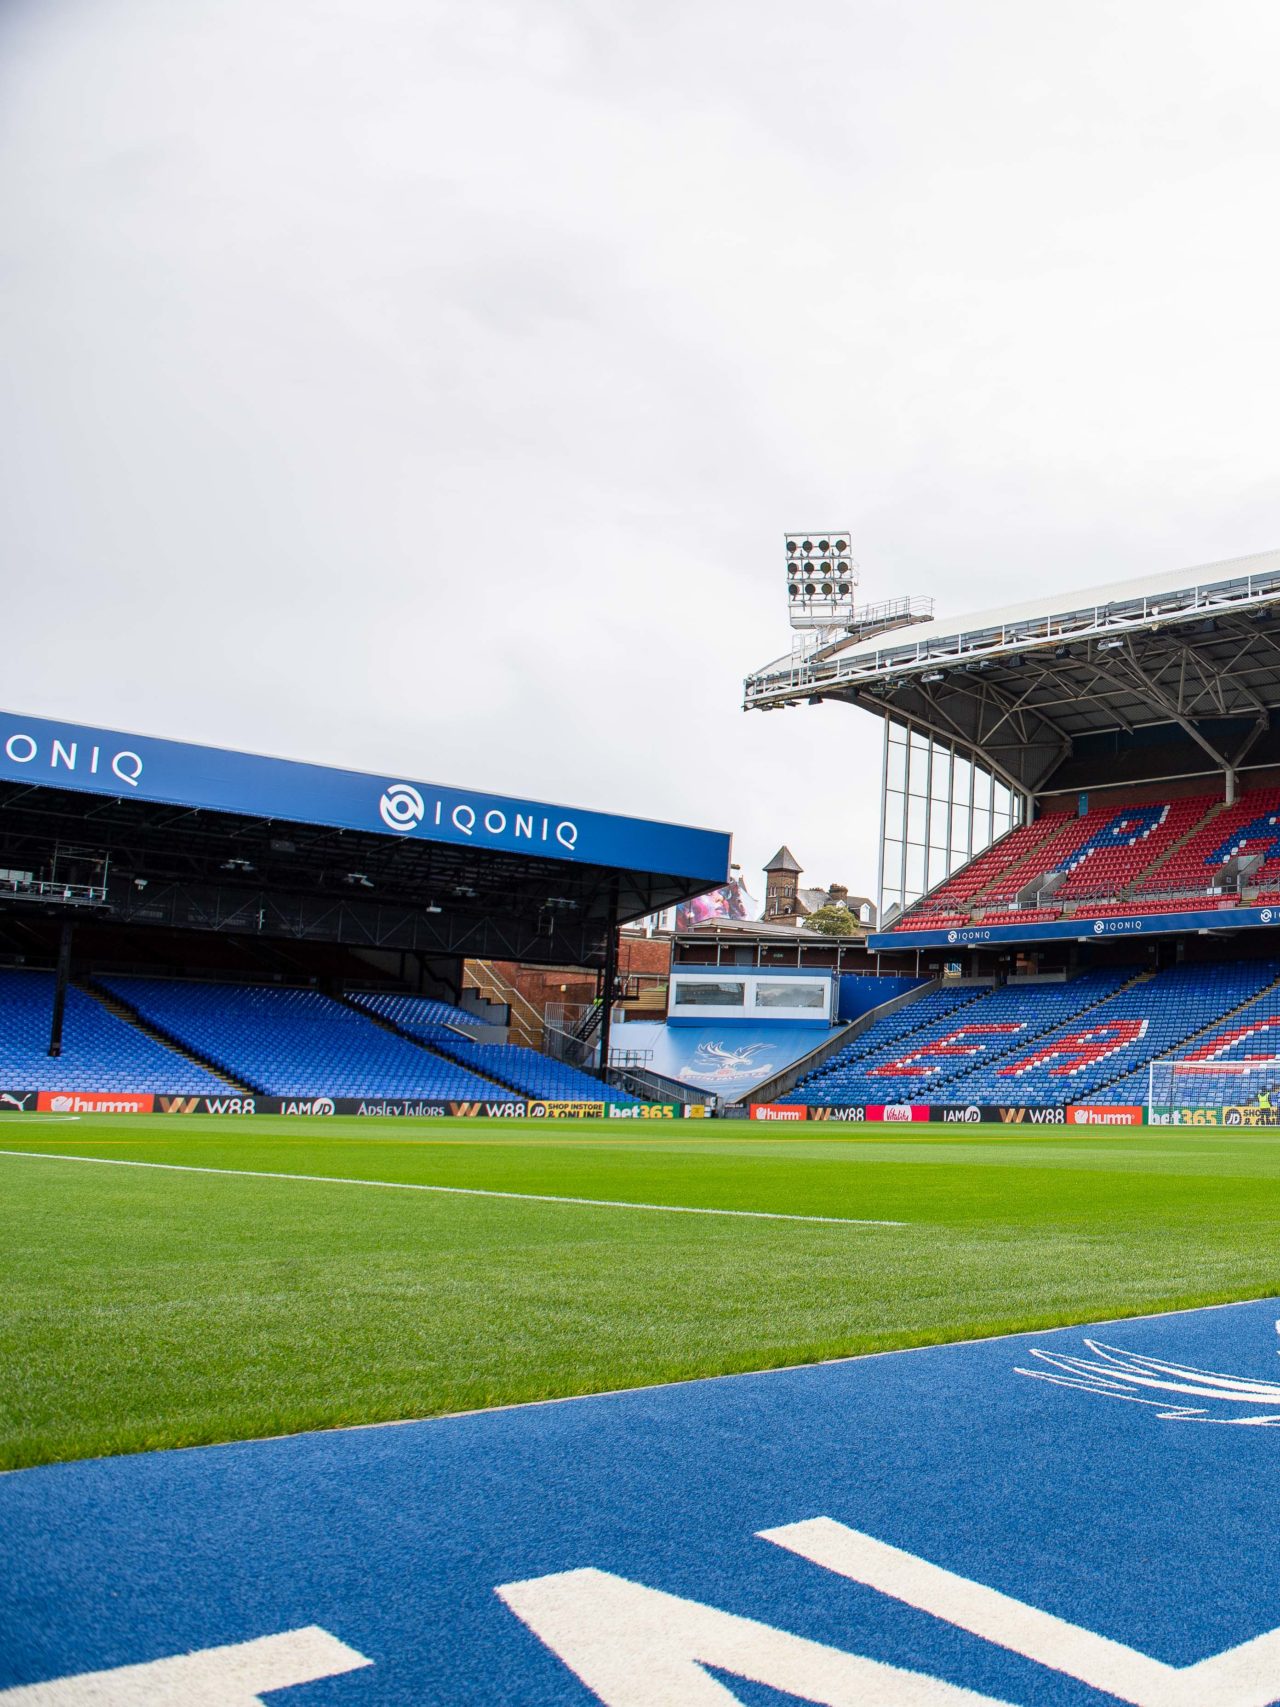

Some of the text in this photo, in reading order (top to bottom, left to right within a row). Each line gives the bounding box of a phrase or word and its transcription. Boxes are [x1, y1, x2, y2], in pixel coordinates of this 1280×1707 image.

[435, 801, 577, 851] IQONIQ
[1105, 920, 1142, 932] IQONIQ
[73, 1096, 139, 1112] humm
[205, 1098, 256, 1114] W88
[486, 1103, 526, 1118] W88
[609, 1104, 674, 1118] bet365
[767, 1108, 800, 1120] humm
[834, 1107, 864, 1121] W88
[887, 1107, 909, 1120] Vitality
[1029, 1109, 1065, 1124] W88
[1089, 1110, 1132, 1124] humm
[1151, 1108, 1218, 1125] bet365
